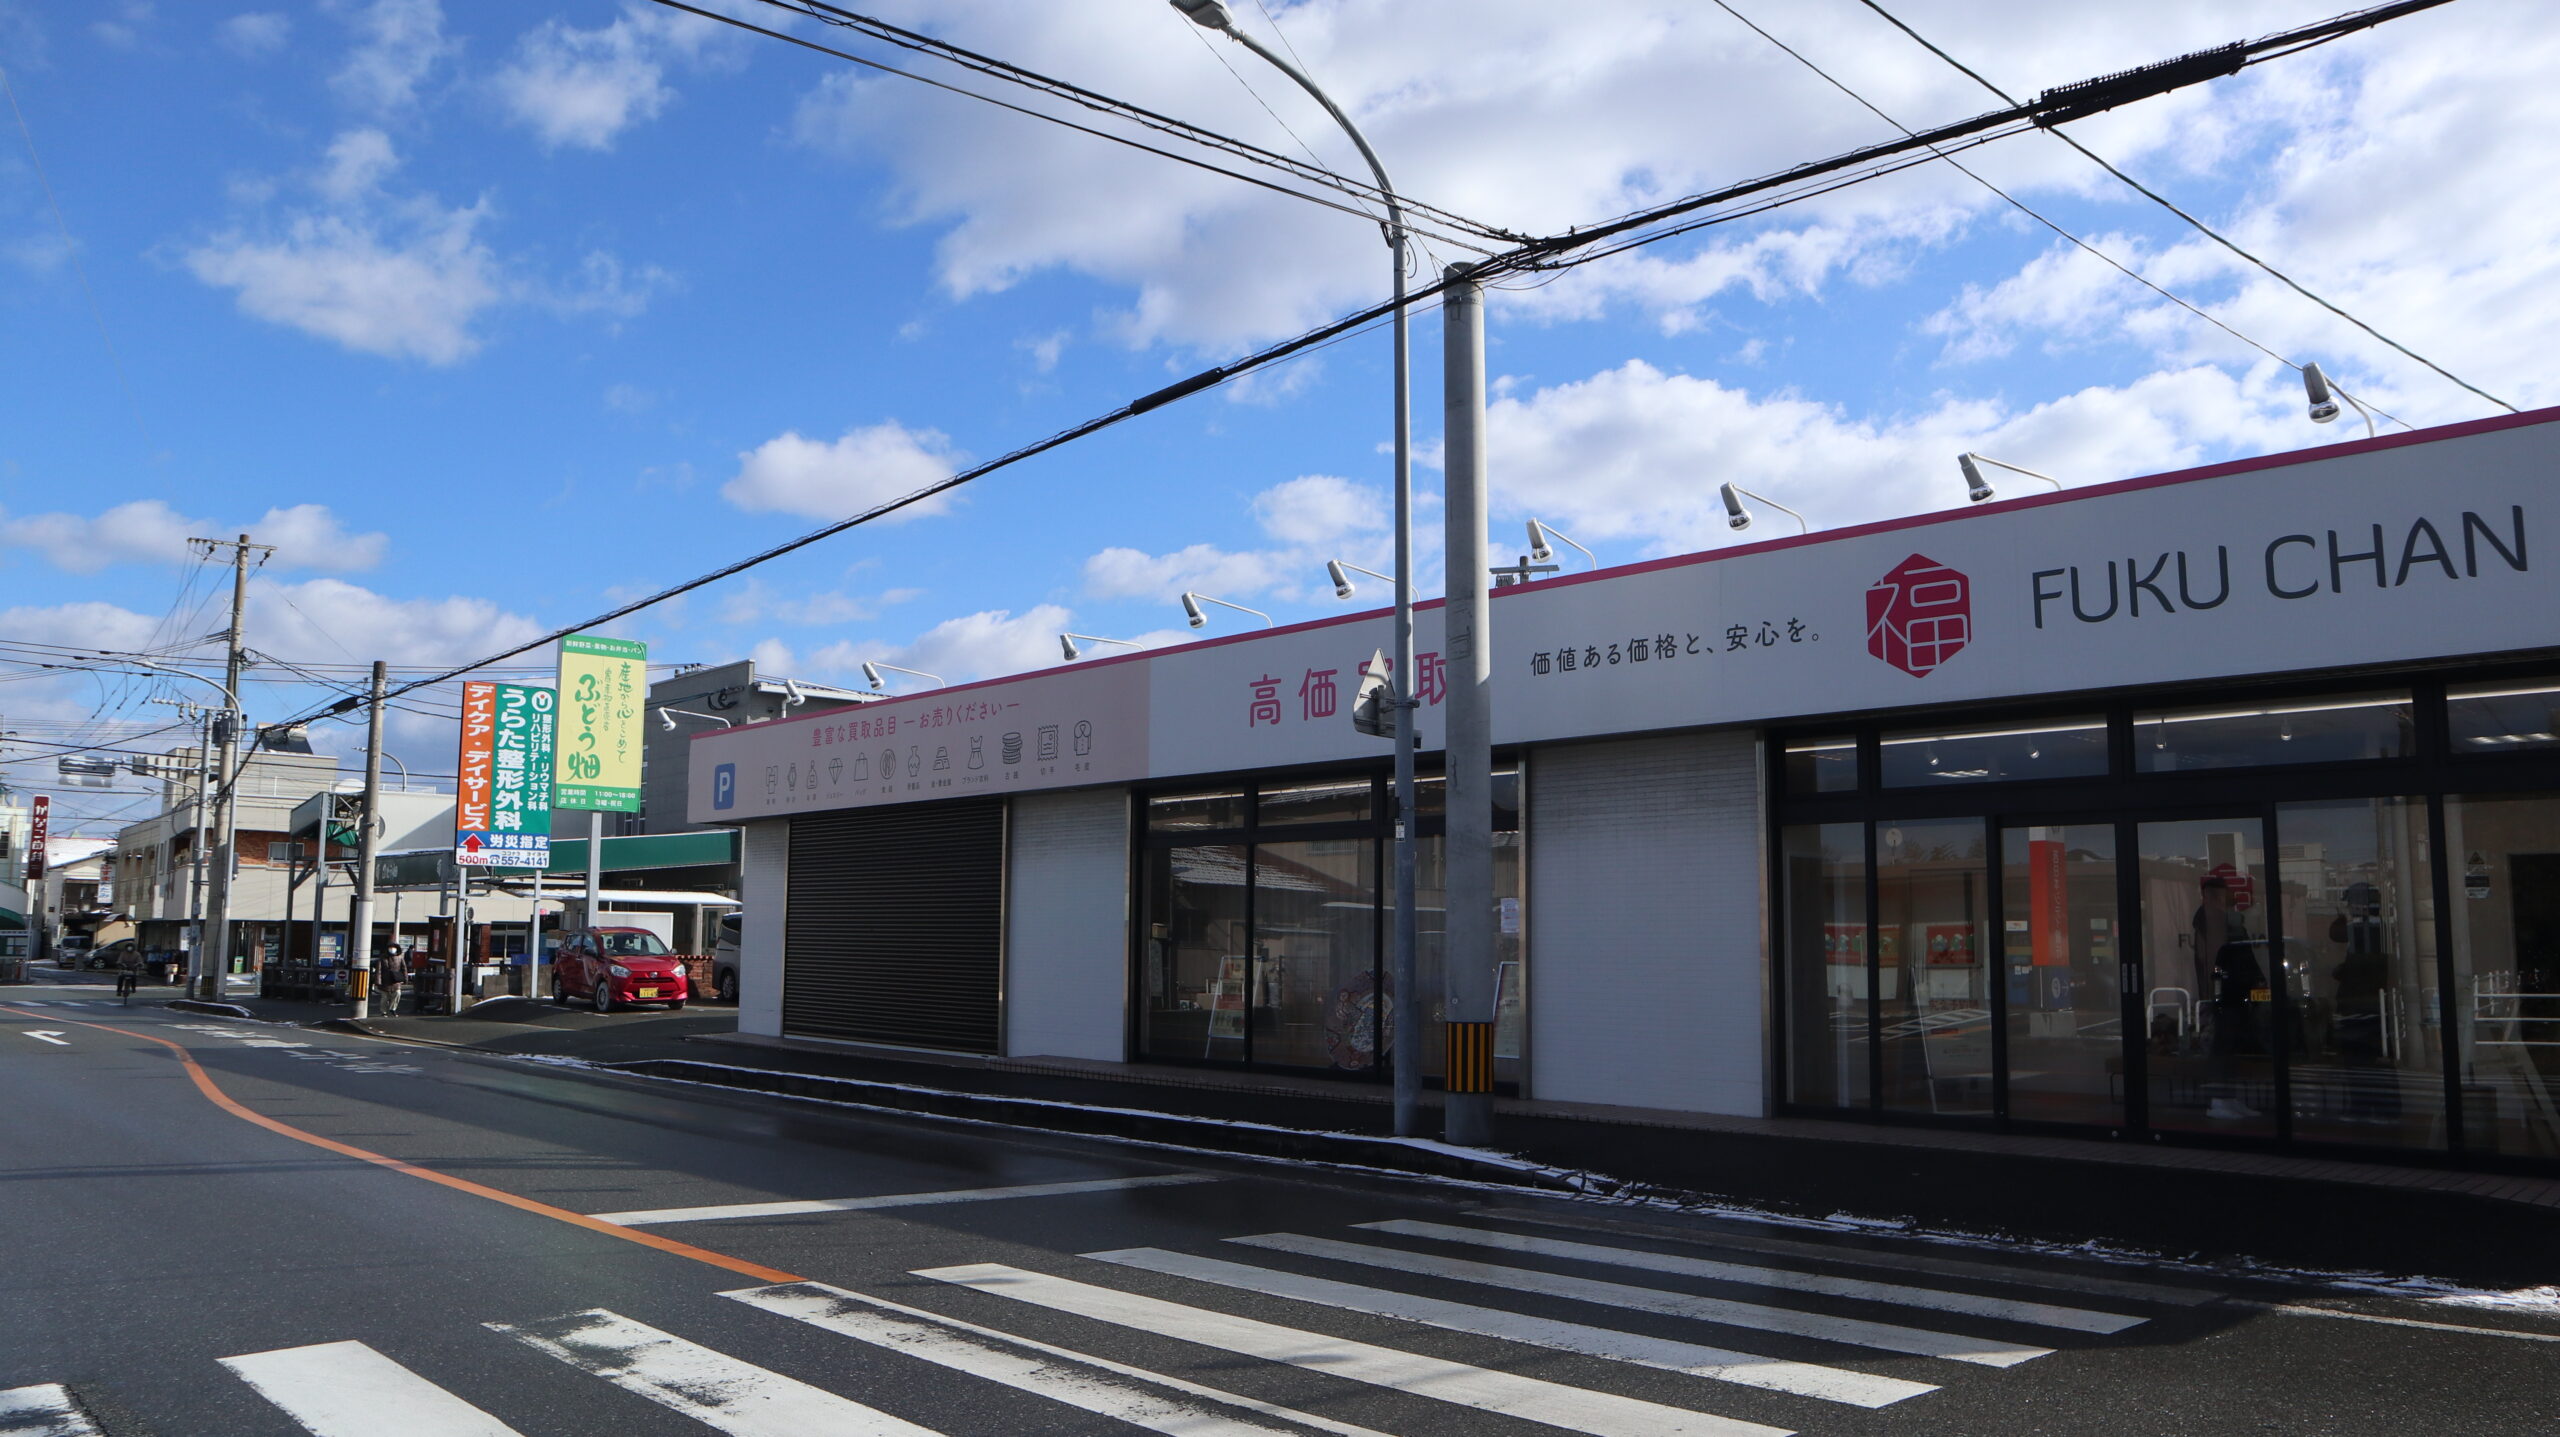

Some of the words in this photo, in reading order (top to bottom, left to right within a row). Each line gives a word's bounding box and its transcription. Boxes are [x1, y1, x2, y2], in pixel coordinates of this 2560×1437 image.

[2031, 544, 2230, 630] FUKU
[2263, 504, 2528, 600] CHAN
[1249, 651, 1447, 728] 高価取
[1530, 617, 1820, 676] 価値ある価格と、安心を。
[462, 684, 495, 830] デイケア・デイサービス
[494, 688, 527, 831] うらた整形外科
[527, 712, 541, 811] リハビリテーション科
[538, 713, 553, 812] 整形外科・リウマチ科
[565, 673, 604, 782] ぶどう畑
[719, 772, 730, 802] P
[458, 855, 488, 865] 500m
[501, 856, 548, 867] 557-4141
[489, 833, 549, 850] 労災指定
